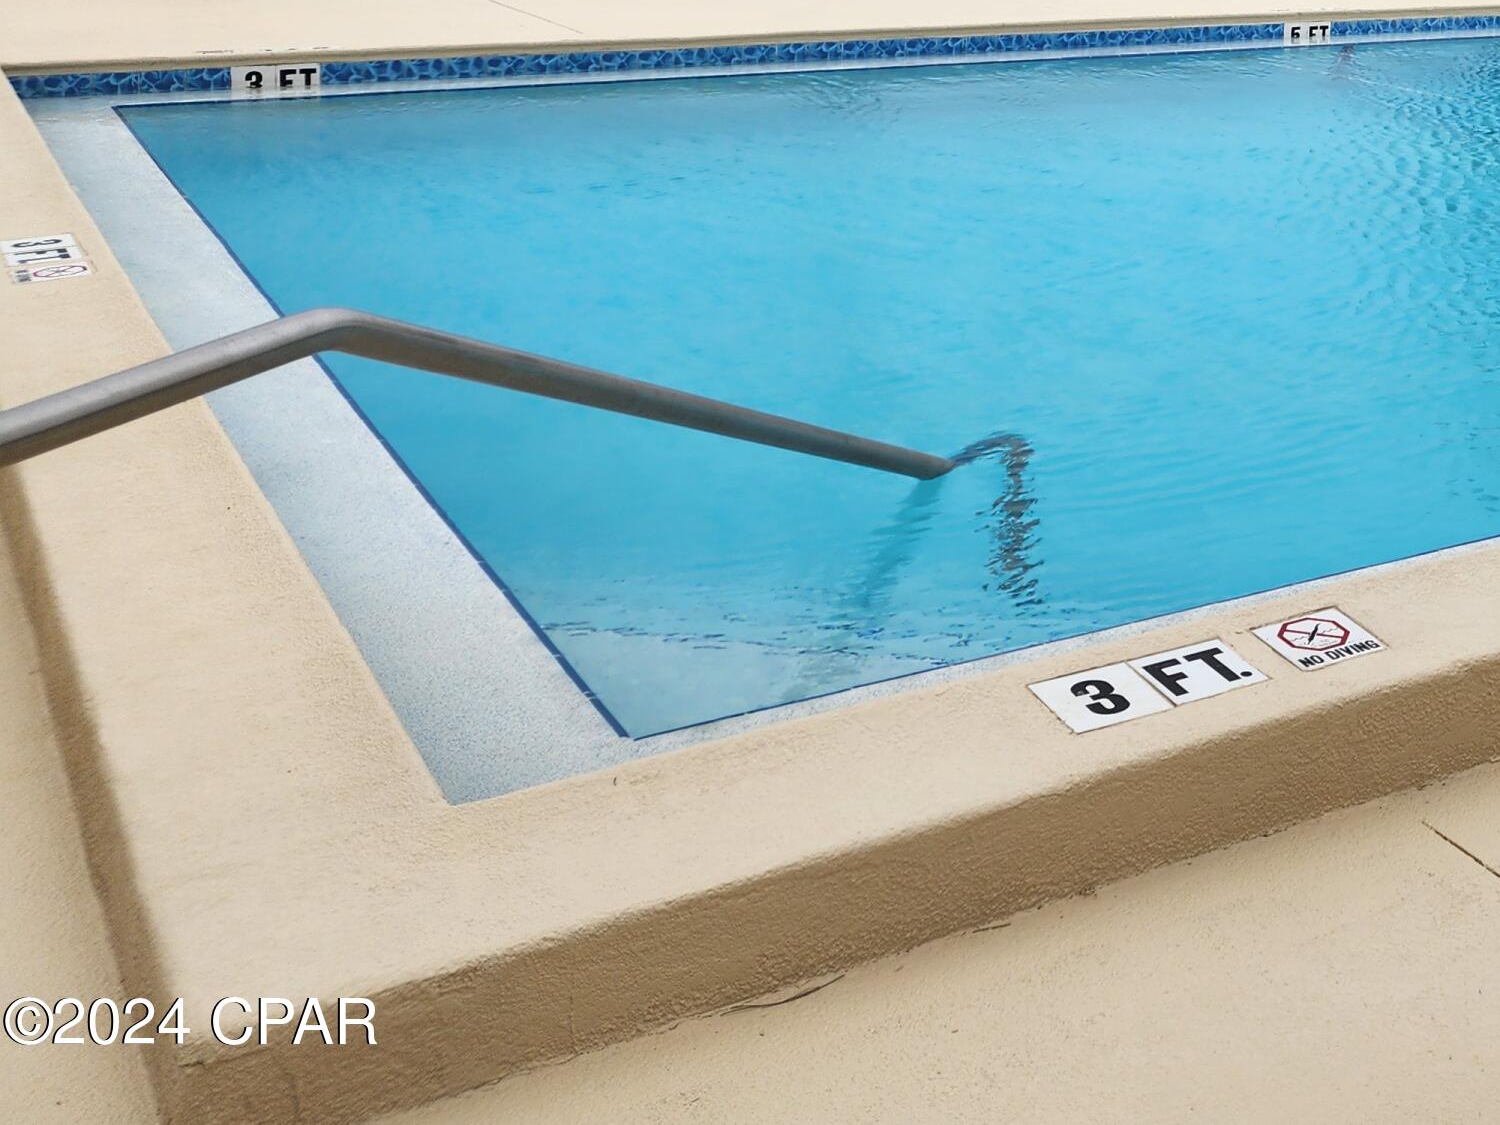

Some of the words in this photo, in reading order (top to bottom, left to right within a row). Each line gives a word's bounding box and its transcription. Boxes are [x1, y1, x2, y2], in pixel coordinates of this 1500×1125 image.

[1309, 25, 1329, 37] FT
[245, 70, 263, 88] 3
[279, 68, 317, 87] FT
[1298, 655, 1325, 668] NO
[1323, 639, 1381, 661] DIVING
[1070, 679, 1131, 715] 3
[1142, 647, 1254, 697] FT.
